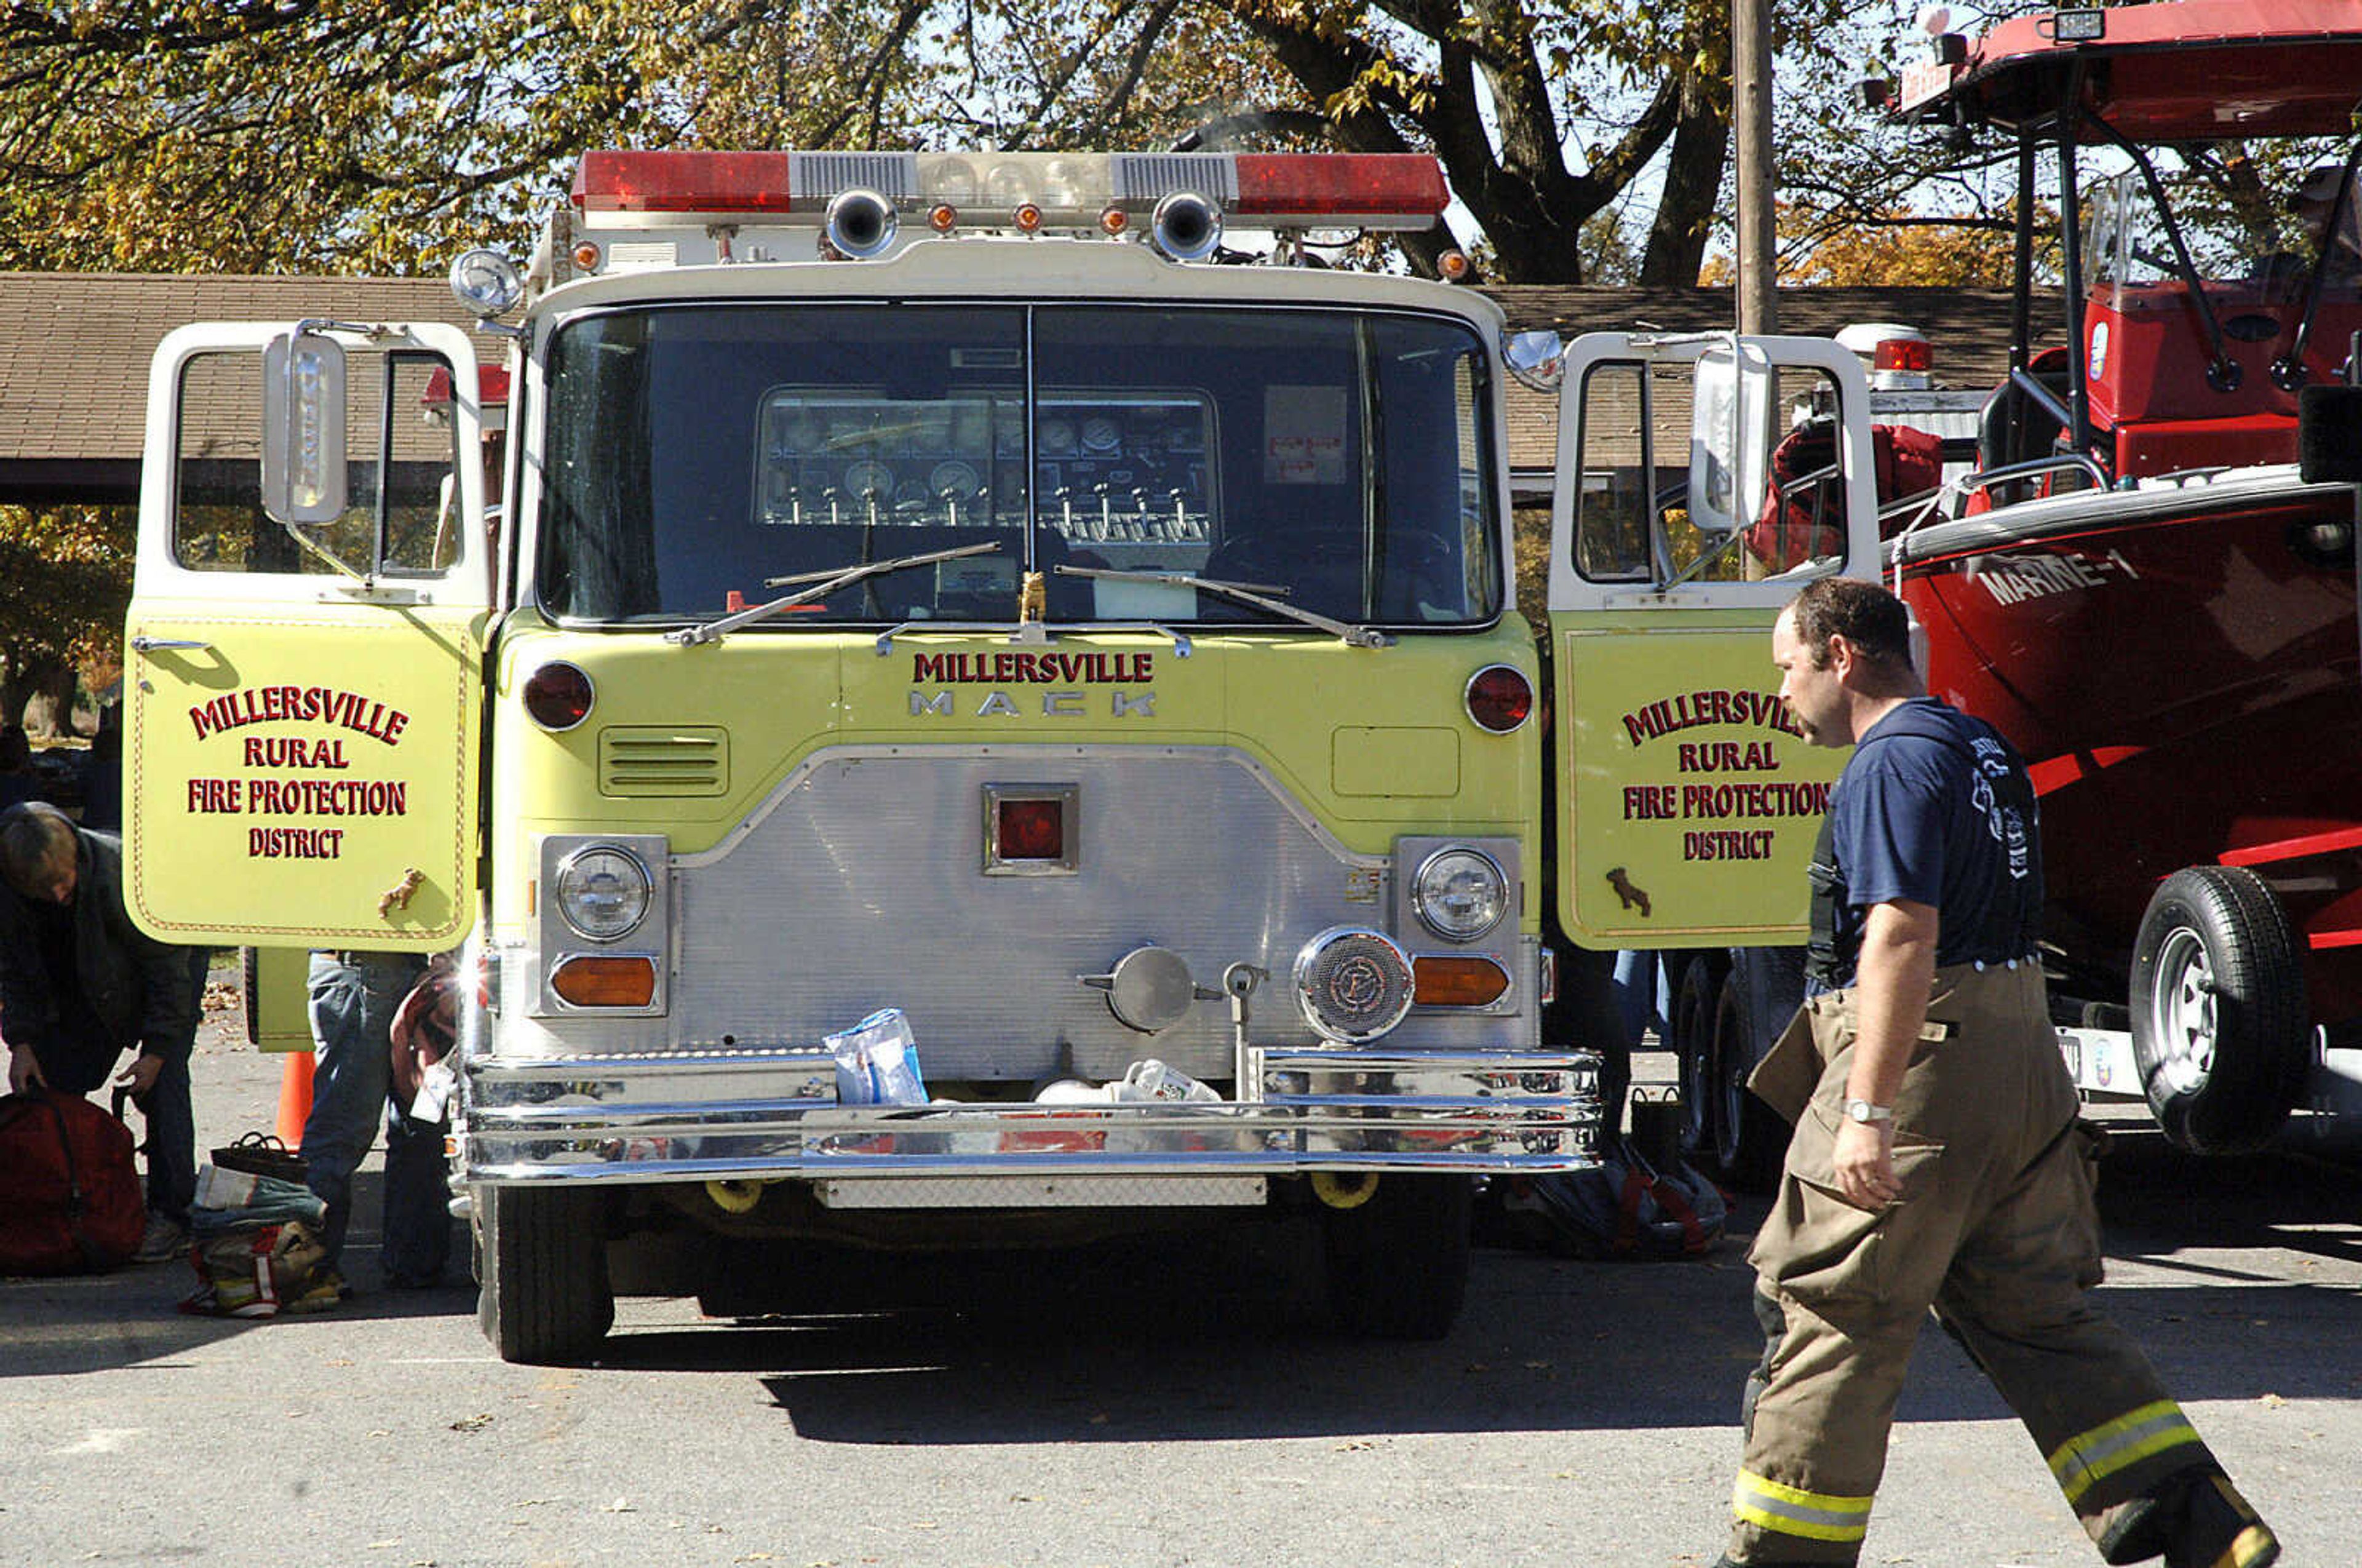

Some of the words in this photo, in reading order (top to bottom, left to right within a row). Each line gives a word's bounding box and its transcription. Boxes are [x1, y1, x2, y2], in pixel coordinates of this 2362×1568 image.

[1976, 549, 2139, 606] MARINE-1
[913, 653, 1153, 684] MILLERSVILLE
[189, 686, 409, 746] MILLERSVILLE
[909, 690, 1156, 718] MACK
[1623, 690, 1806, 747] MILLERSVIL
[244, 738, 349, 768] RURAL
[1679, 741, 1781, 772] RURAL
[188, 779, 242, 813] FIRE
[248, 779, 406, 816] PROTECTION
[1623, 785, 1677, 820] FIRE
[1683, 782, 1831, 819] PROTECTION
[249, 828, 343, 859] DISTRICT
[1684, 830, 1775, 861] DISTRICT
